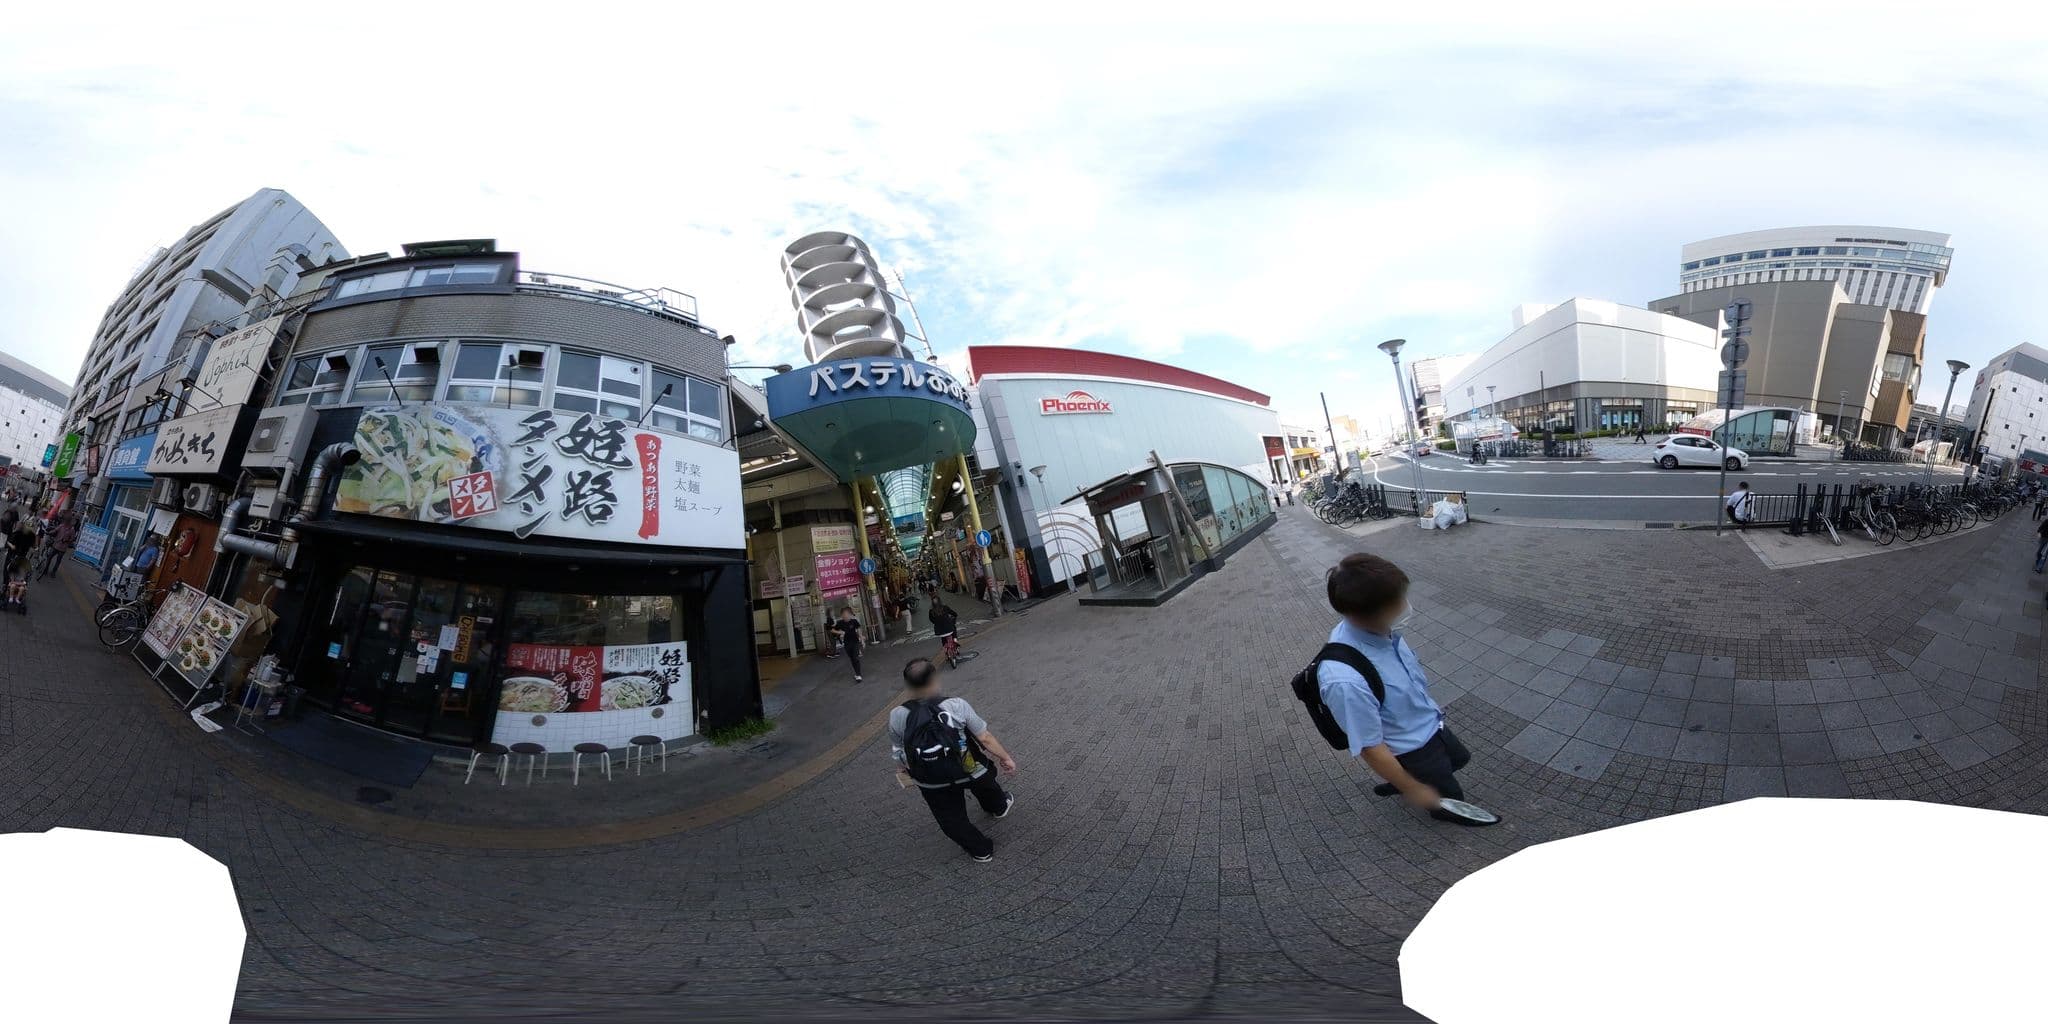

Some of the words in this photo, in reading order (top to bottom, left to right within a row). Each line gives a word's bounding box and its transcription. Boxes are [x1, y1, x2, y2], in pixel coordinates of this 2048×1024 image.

[1042, 398, 1111, 413] Phoenix
[504, 410, 558, 540] タンメン
[553, 412, 634, 526] 姫路
[645, 439, 658, 512] あつあつ野菜
[674, 459, 702, 477] 野菜
[674, 496, 723, 516] 塩スープ
